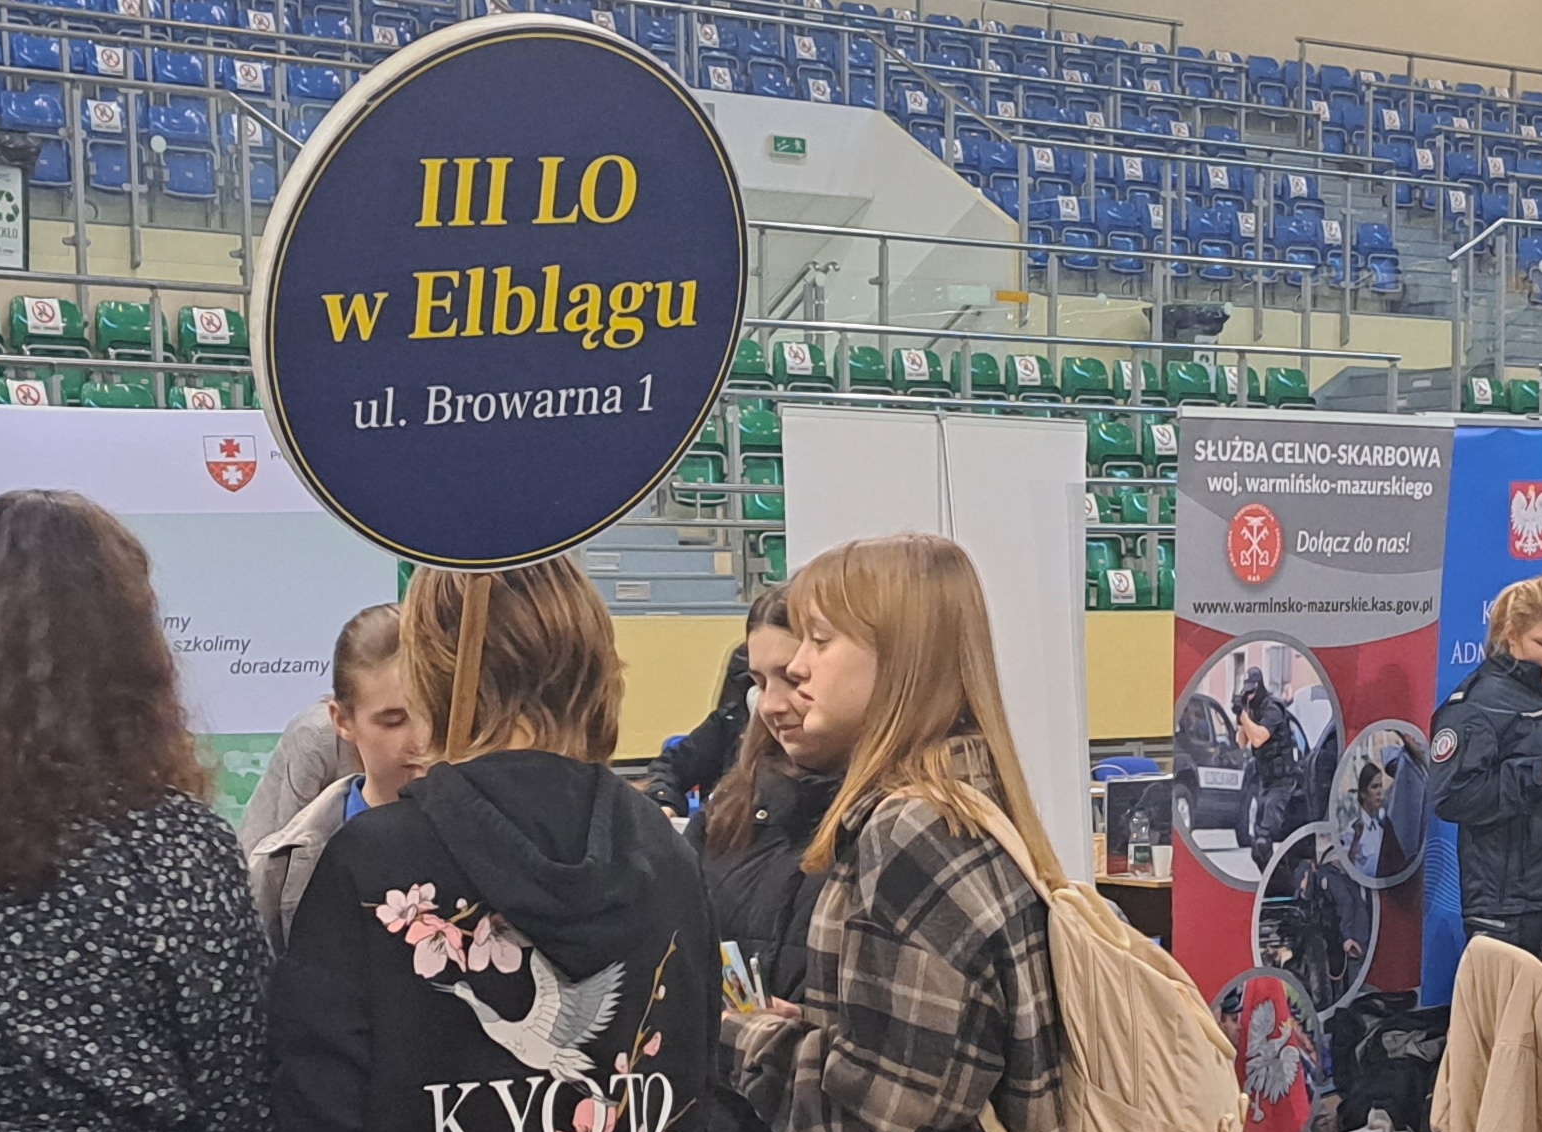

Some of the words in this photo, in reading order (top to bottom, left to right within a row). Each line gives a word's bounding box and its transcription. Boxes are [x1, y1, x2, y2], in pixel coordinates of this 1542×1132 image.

[415, 157, 514, 228] III
[532, 154, 637, 225] LO
[322, 293, 388, 342] w
[408, 265, 698, 350] Elblągu
[354, 388, 407, 429] ul.
[424, 384, 622, 425] Browarna
[638, 375, 654, 411] 1
[1194, 436, 1268, 463] SŁUŻBA
[1272, 443, 1441, 468] CELNO-SKARBOWA
[1207, 472, 1242, 496] woj.
[1246, 473, 1432, 500] warmińsko-mazurskiego
[1297, 530, 1350, 557] Dołącz
[1354, 531, 1372, 552] do
[1376, 532, 1410, 553] nas!
[1193, 597, 1433, 615] www.warminsko-mazurskie.kas.gov.pl
[173, 635, 251, 655] szkolimy
[230, 658, 330, 676] doradzamy
